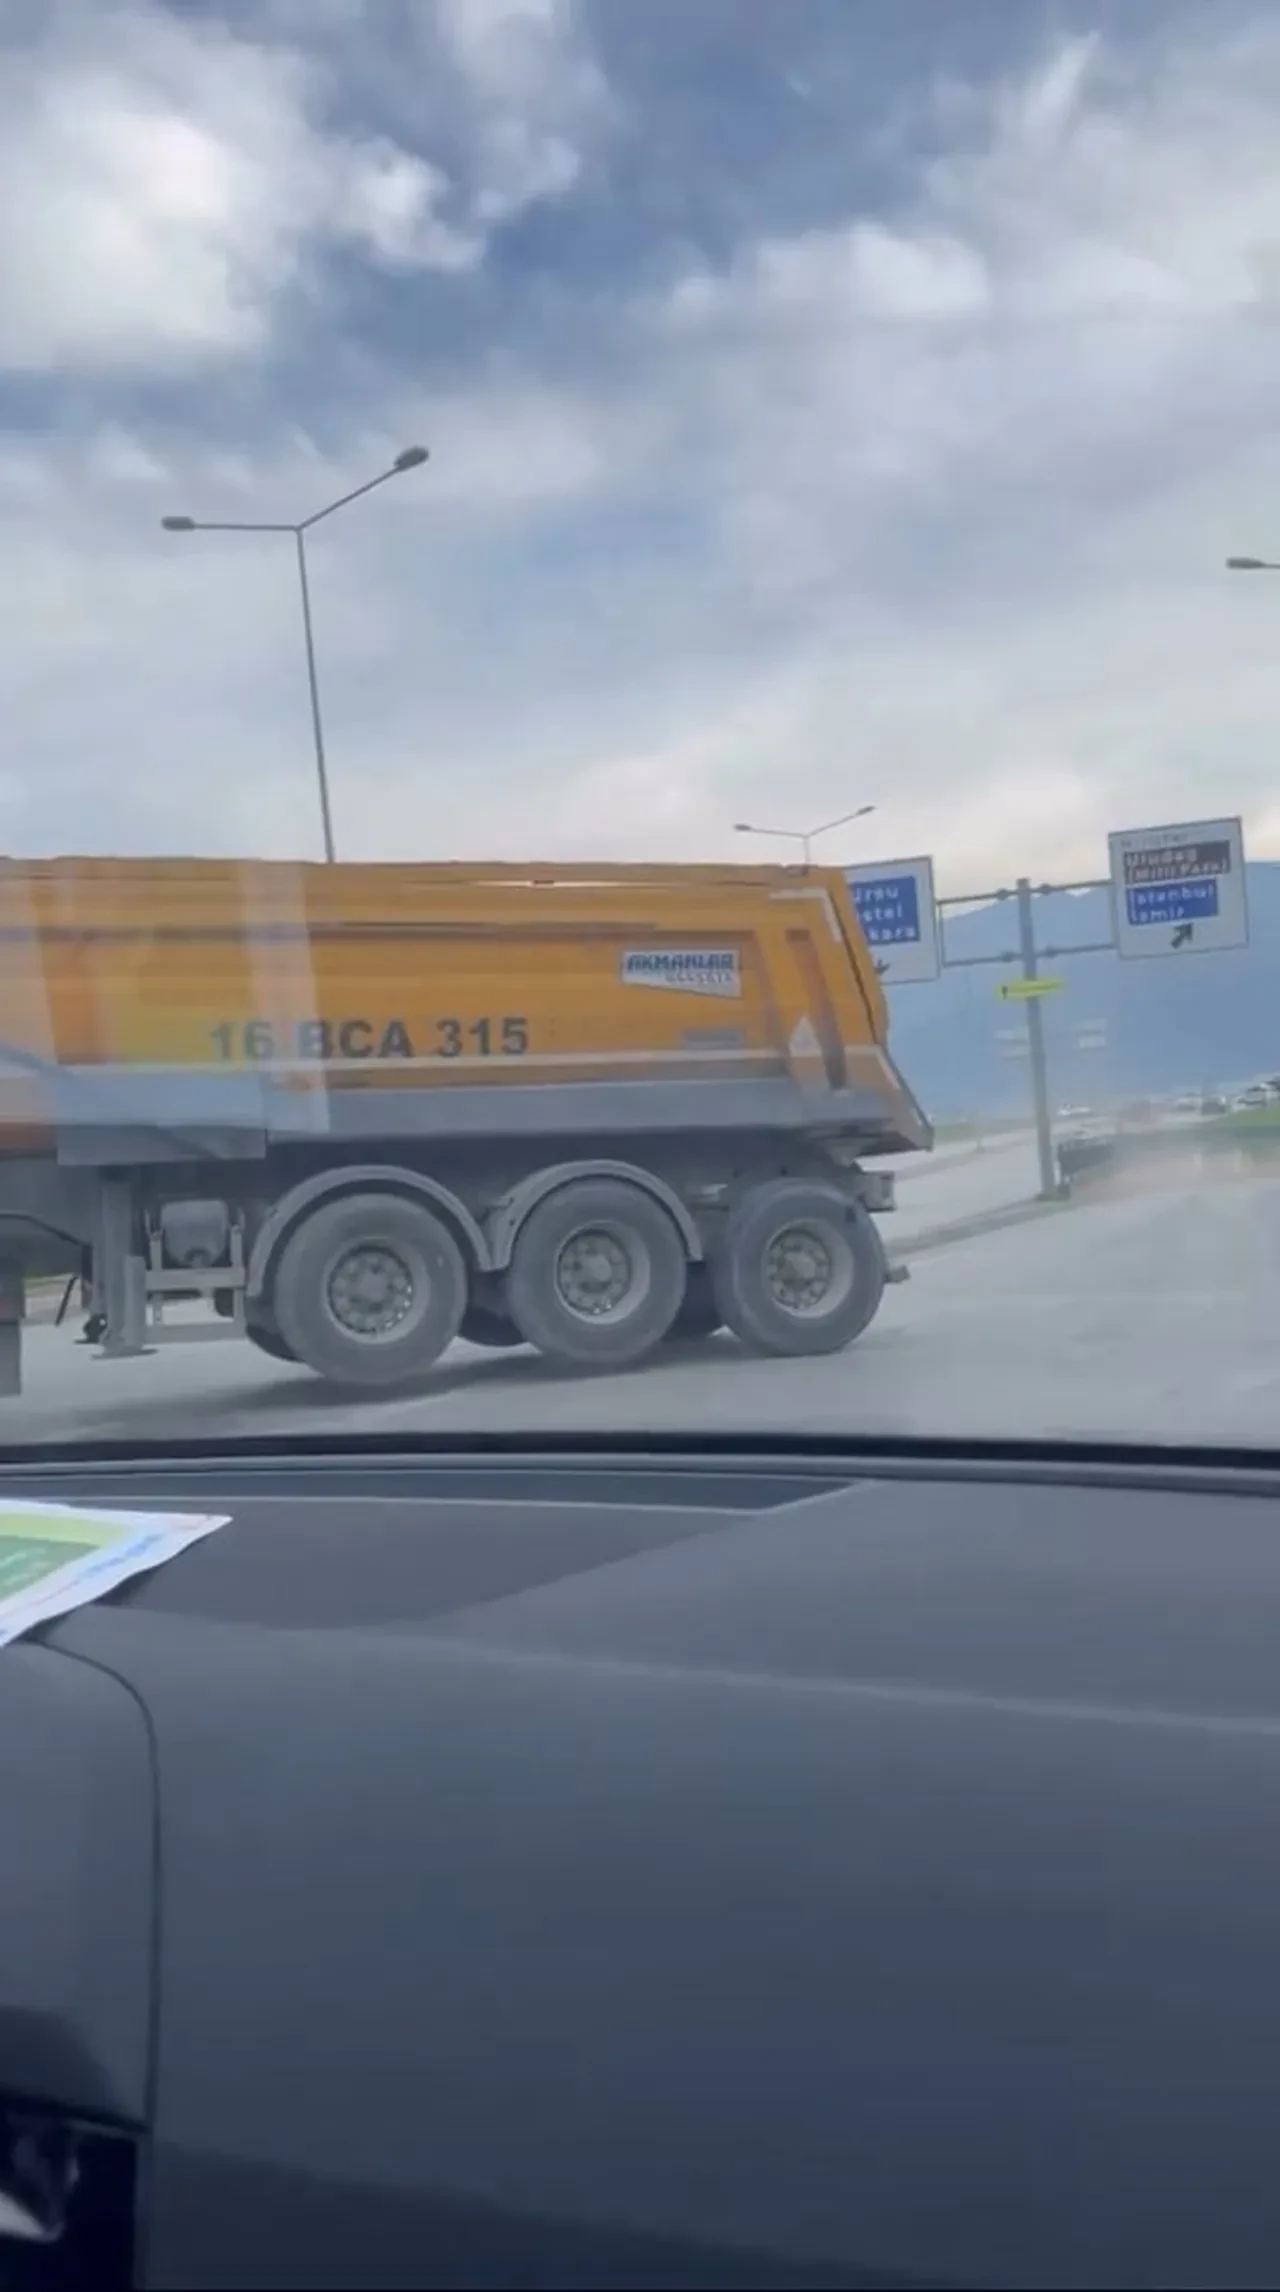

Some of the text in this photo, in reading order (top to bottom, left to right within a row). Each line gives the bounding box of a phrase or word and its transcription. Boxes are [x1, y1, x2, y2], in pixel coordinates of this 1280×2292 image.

[626, 953, 734, 972] AKMANLAR
[210, 1016, 529, 1059] 16 BCA 315
